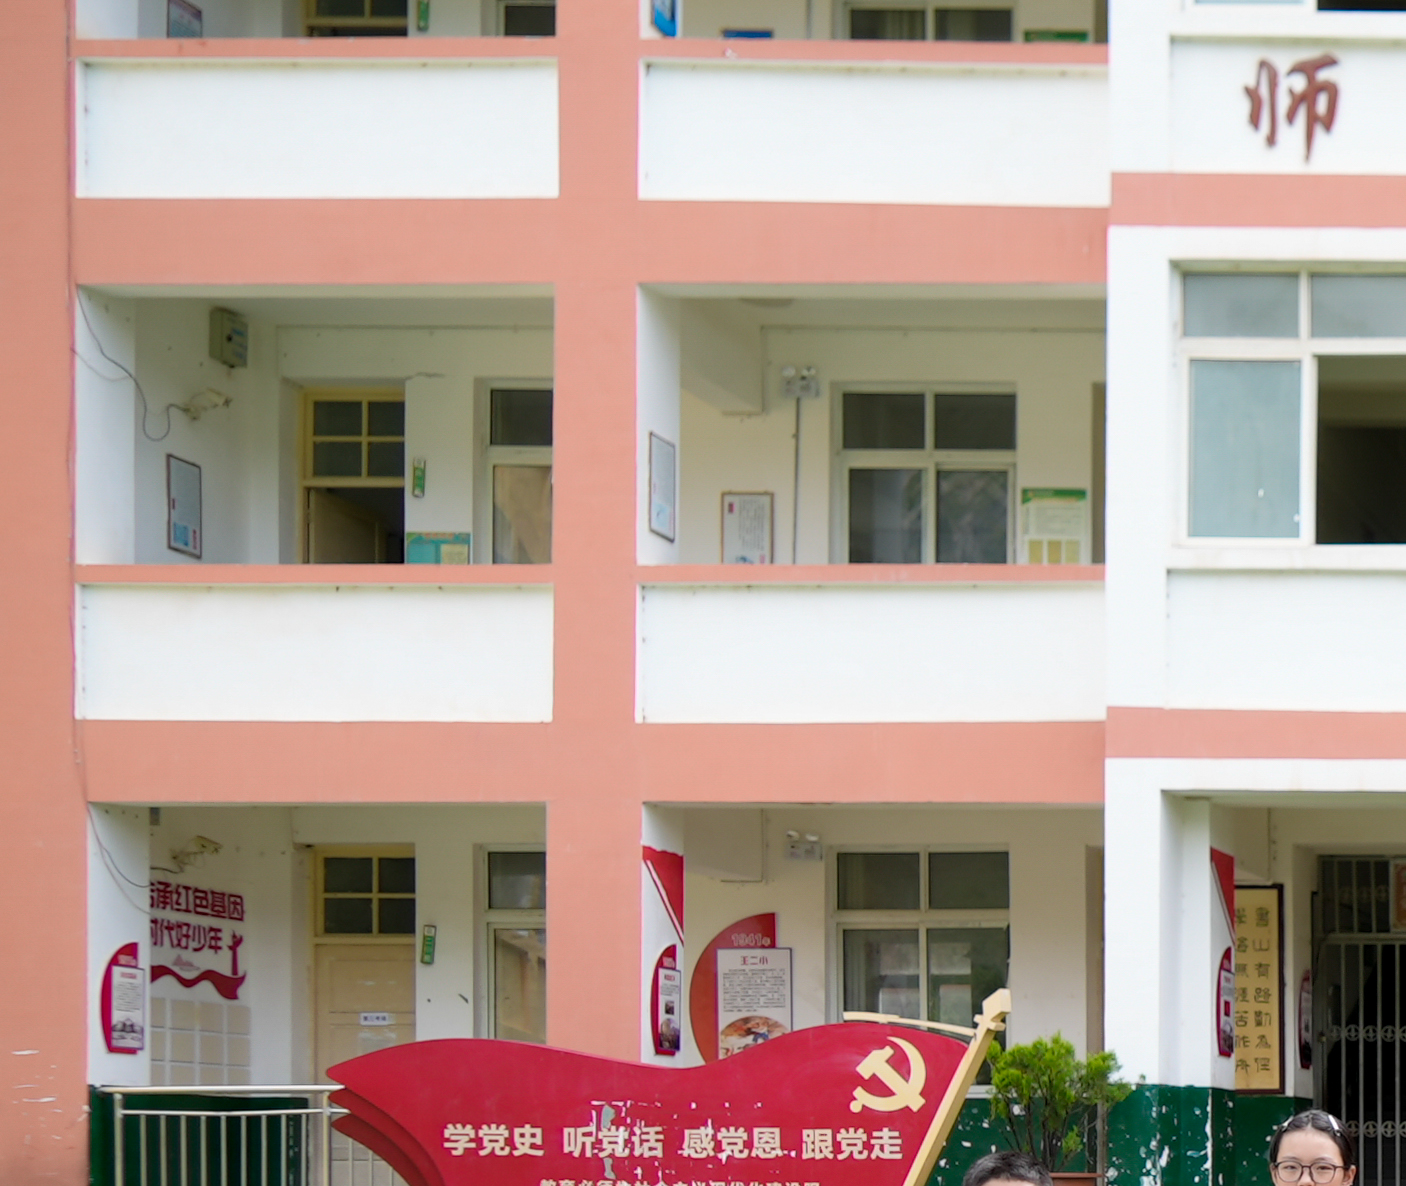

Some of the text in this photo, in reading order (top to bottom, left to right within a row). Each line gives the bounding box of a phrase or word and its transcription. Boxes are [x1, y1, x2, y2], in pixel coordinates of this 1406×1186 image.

[150, 878, 245, 921] 承红色基因
[443, 1123, 903, 1161] 学党史 听党话 感党恩 跟党走
